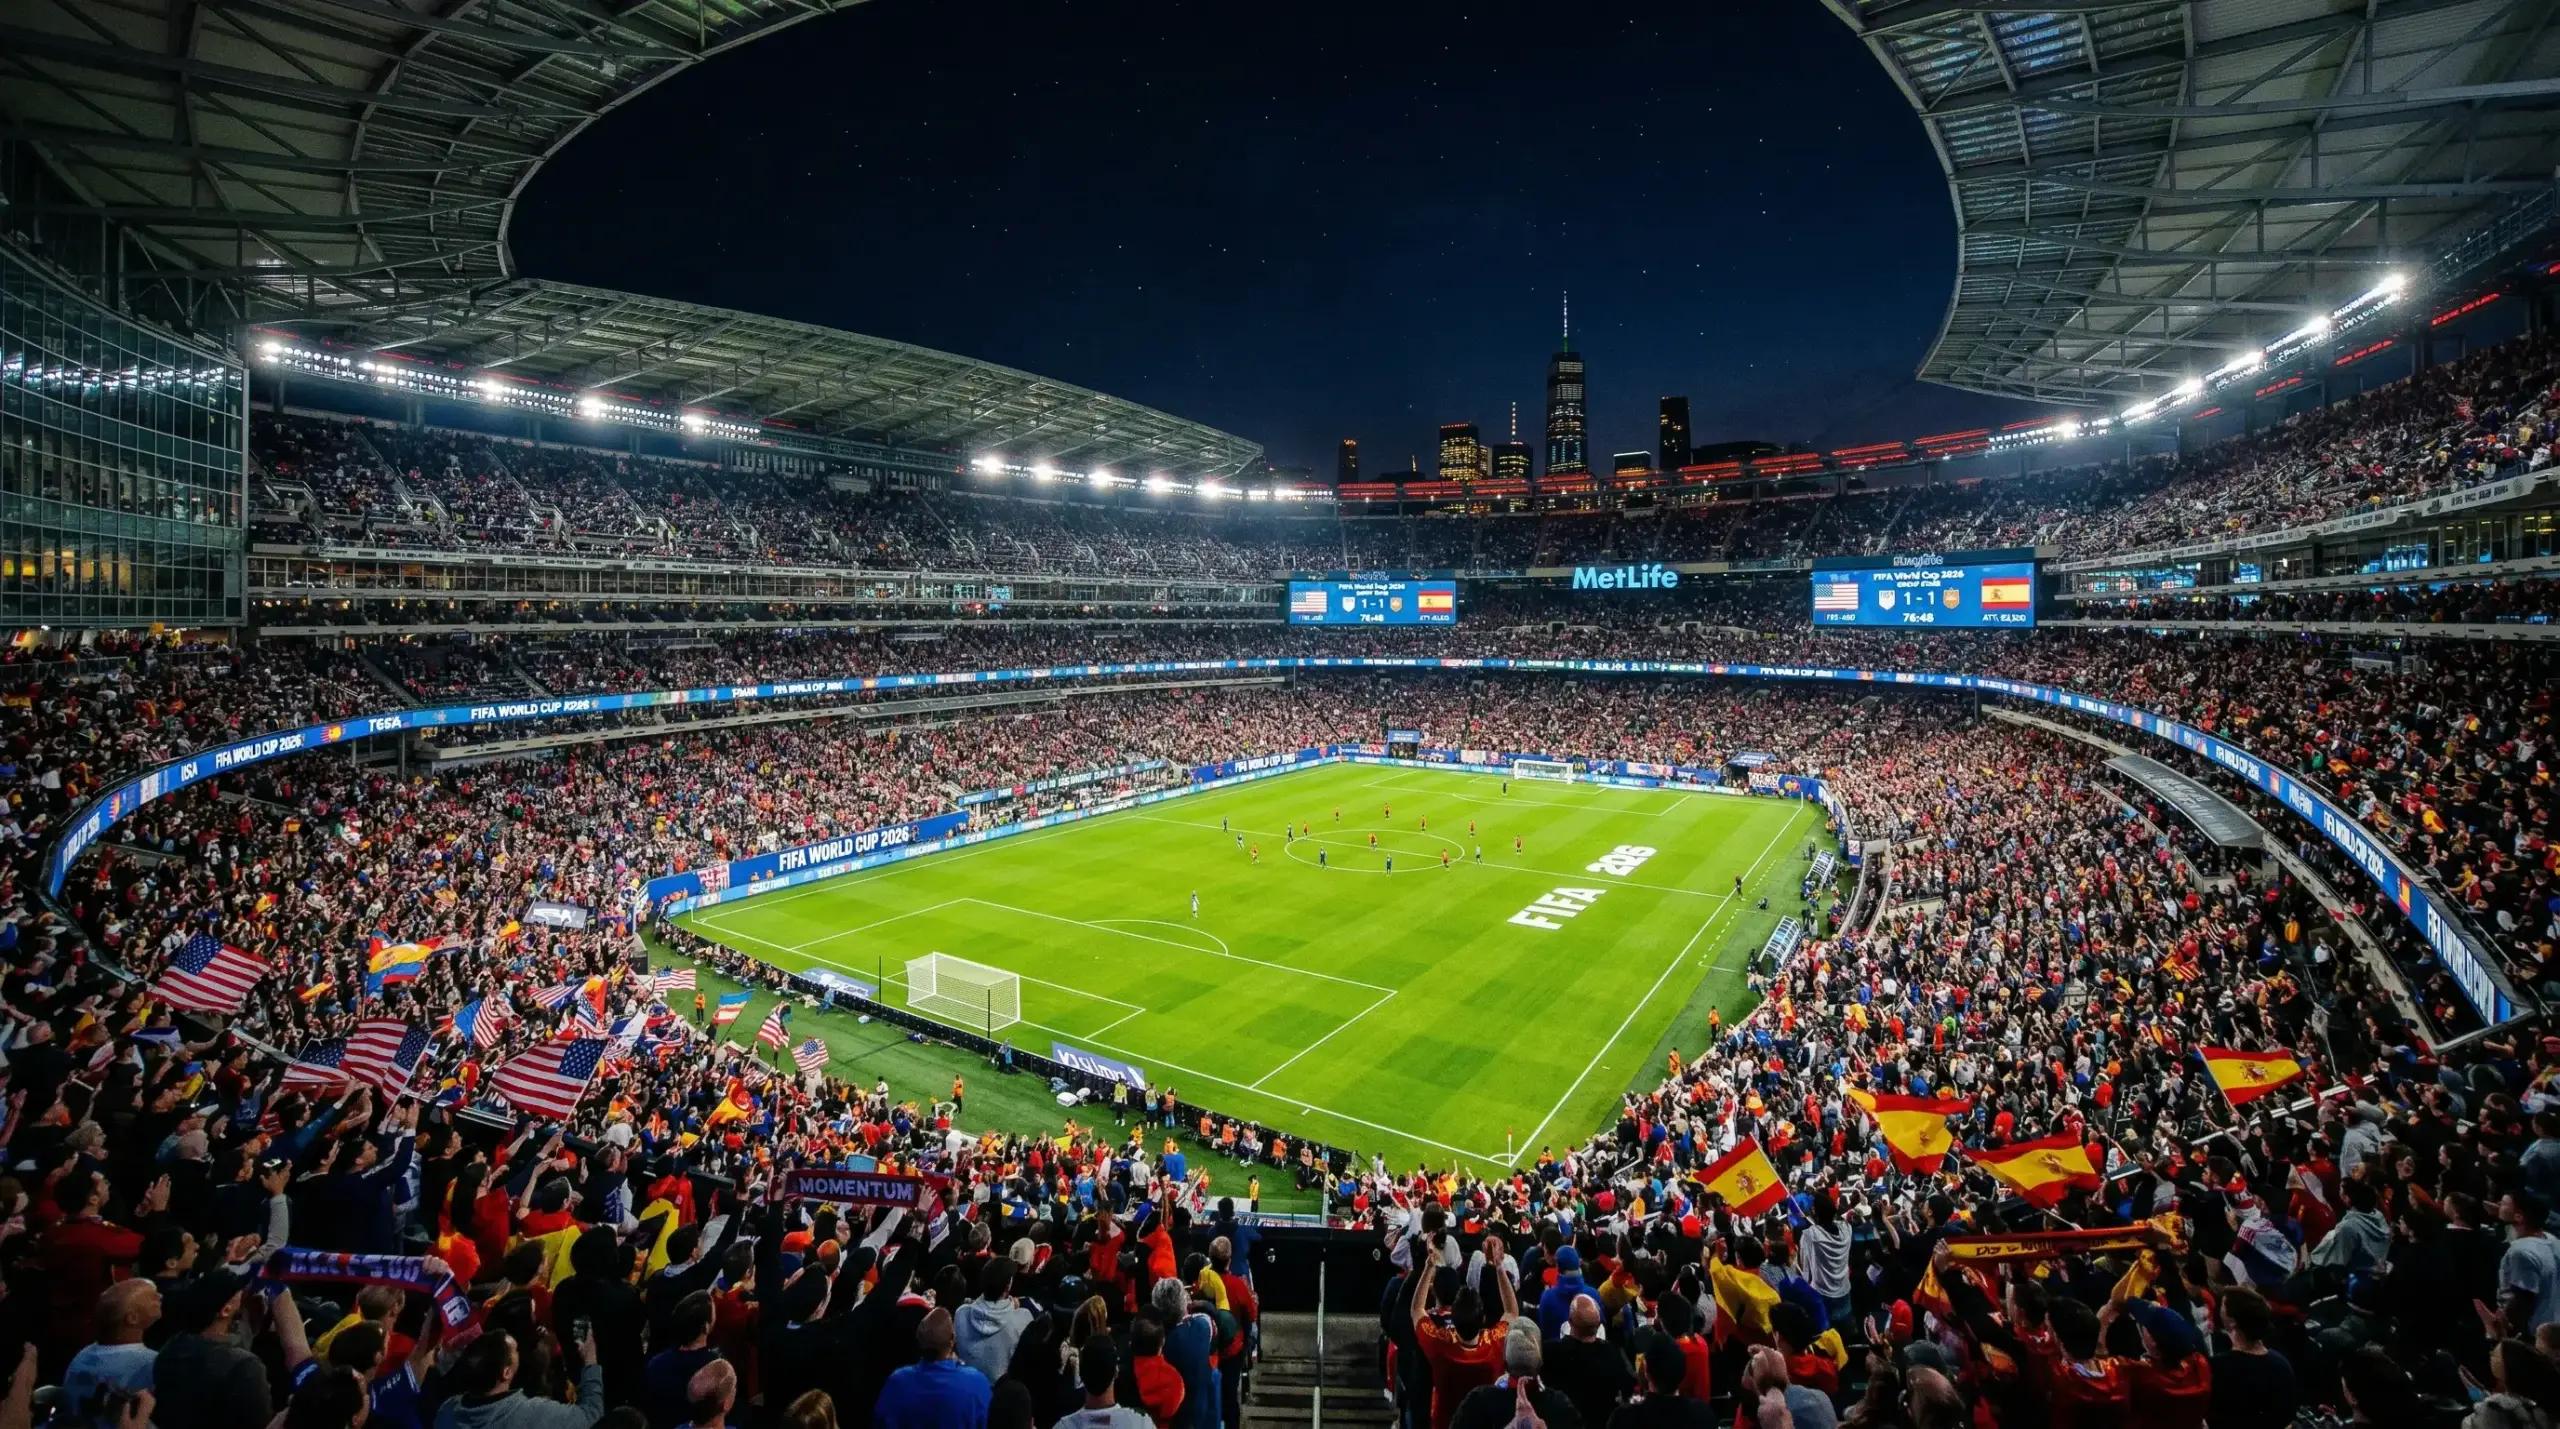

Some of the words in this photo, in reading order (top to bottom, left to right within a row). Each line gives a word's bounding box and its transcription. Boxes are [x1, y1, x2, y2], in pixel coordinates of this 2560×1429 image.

[1572, 563, 1678, 589] MetLife
[471, 708, 496, 719] FIFA
[498, 704, 538, 717] WORLD
[541, 702, 562, 713] CUP
[216, 752, 232, 769] FIFA
[232, 743, 261, 763] WORLD
[262, 739, 279, 755] CUP
[280, 734, 302, 751] 2026
[779, 848, 806, 872] FIFA
[808, 838, 853, 864] WORLD
[855, 832, 879, 853] CUP
[880, 825, 910, 848] 2026
[1507, 887, 1608, 930] FIFA
[799, 1177, 914, 1201] MOMENTUM
